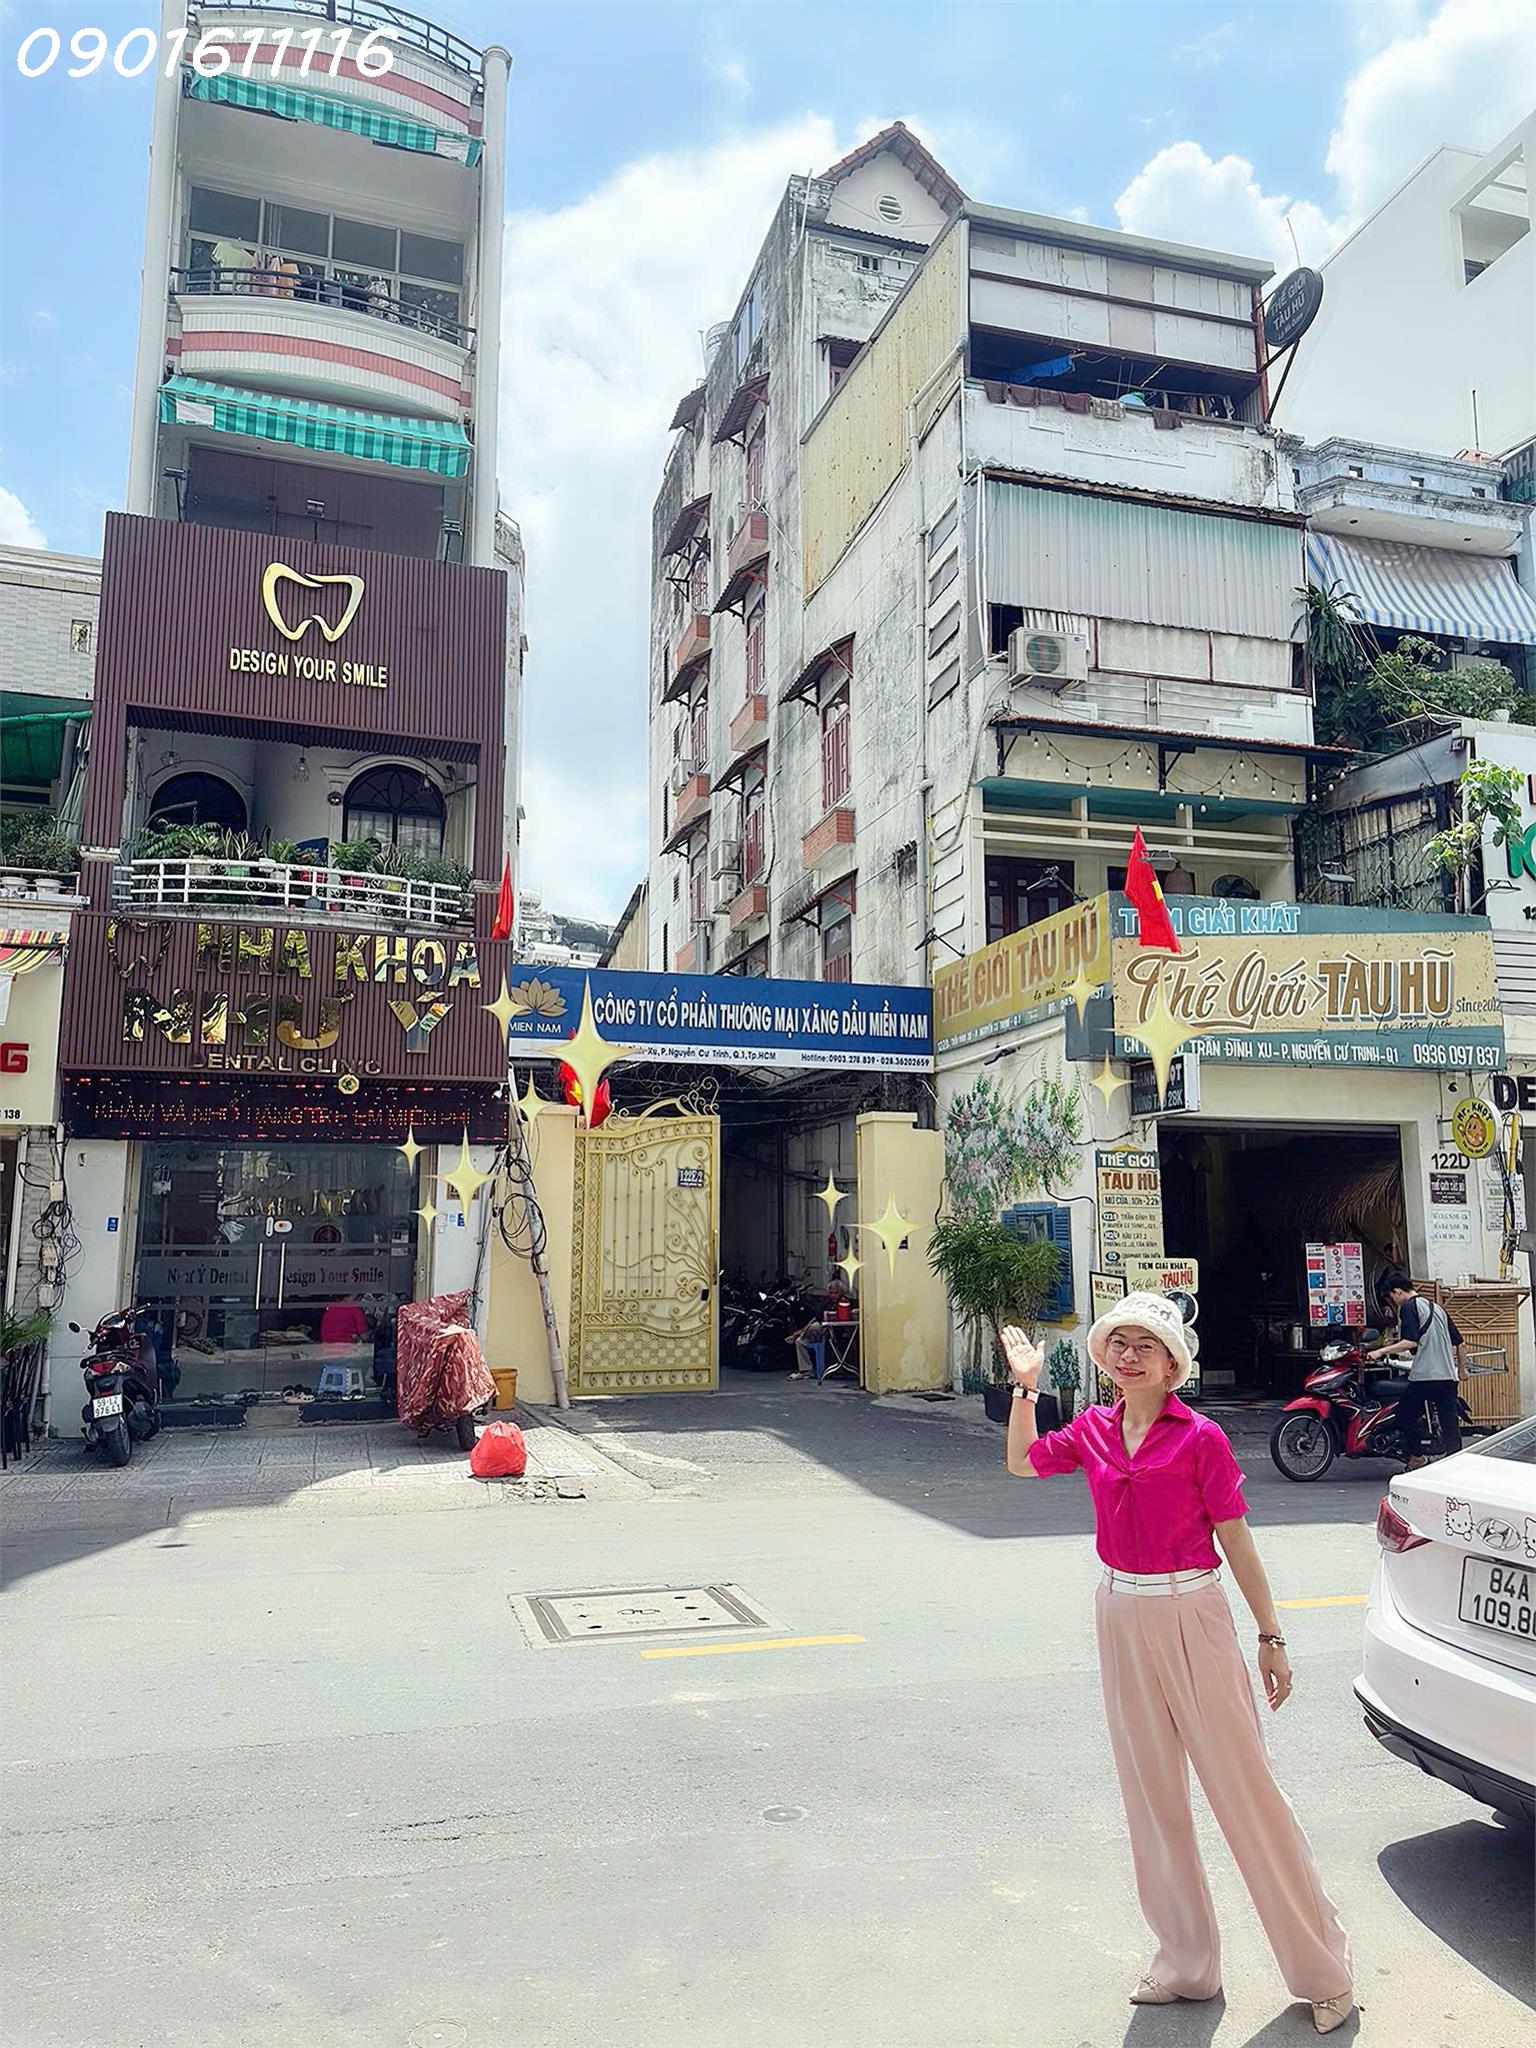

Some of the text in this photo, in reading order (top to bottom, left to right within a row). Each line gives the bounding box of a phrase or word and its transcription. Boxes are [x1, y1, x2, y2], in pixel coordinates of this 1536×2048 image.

[230, 648, 387, 688] DESIGN YOUR SMILE
[196, 923, 481, 988] NHA KHOA
[1318, 951, 1396, 1021] TÀU
[1399, 948, 1455, 1019] HŨ
[123, 986, 454, 1053] NHƯ Ý
[537, 1023, 561, 1033] NAM
[595, 987, 928, 1039] CÔNG TY CỔ PHẦN THƯƠNG MẠI XĂNG DẦU MIỀN NAM
[1124, 1038, 1139, 1053] CN
[1189, 1035, 1220, 1057] TRẦN
[1334, 1041, 1349, 1061] CƯ
[1414, 1044, 1499, 1067] 0936 097 837
[4, 1109, 21, 1119] 138
[352, 1266, 384, 1283] Smile
[1490, 1567, 1529, 1602] 84A
